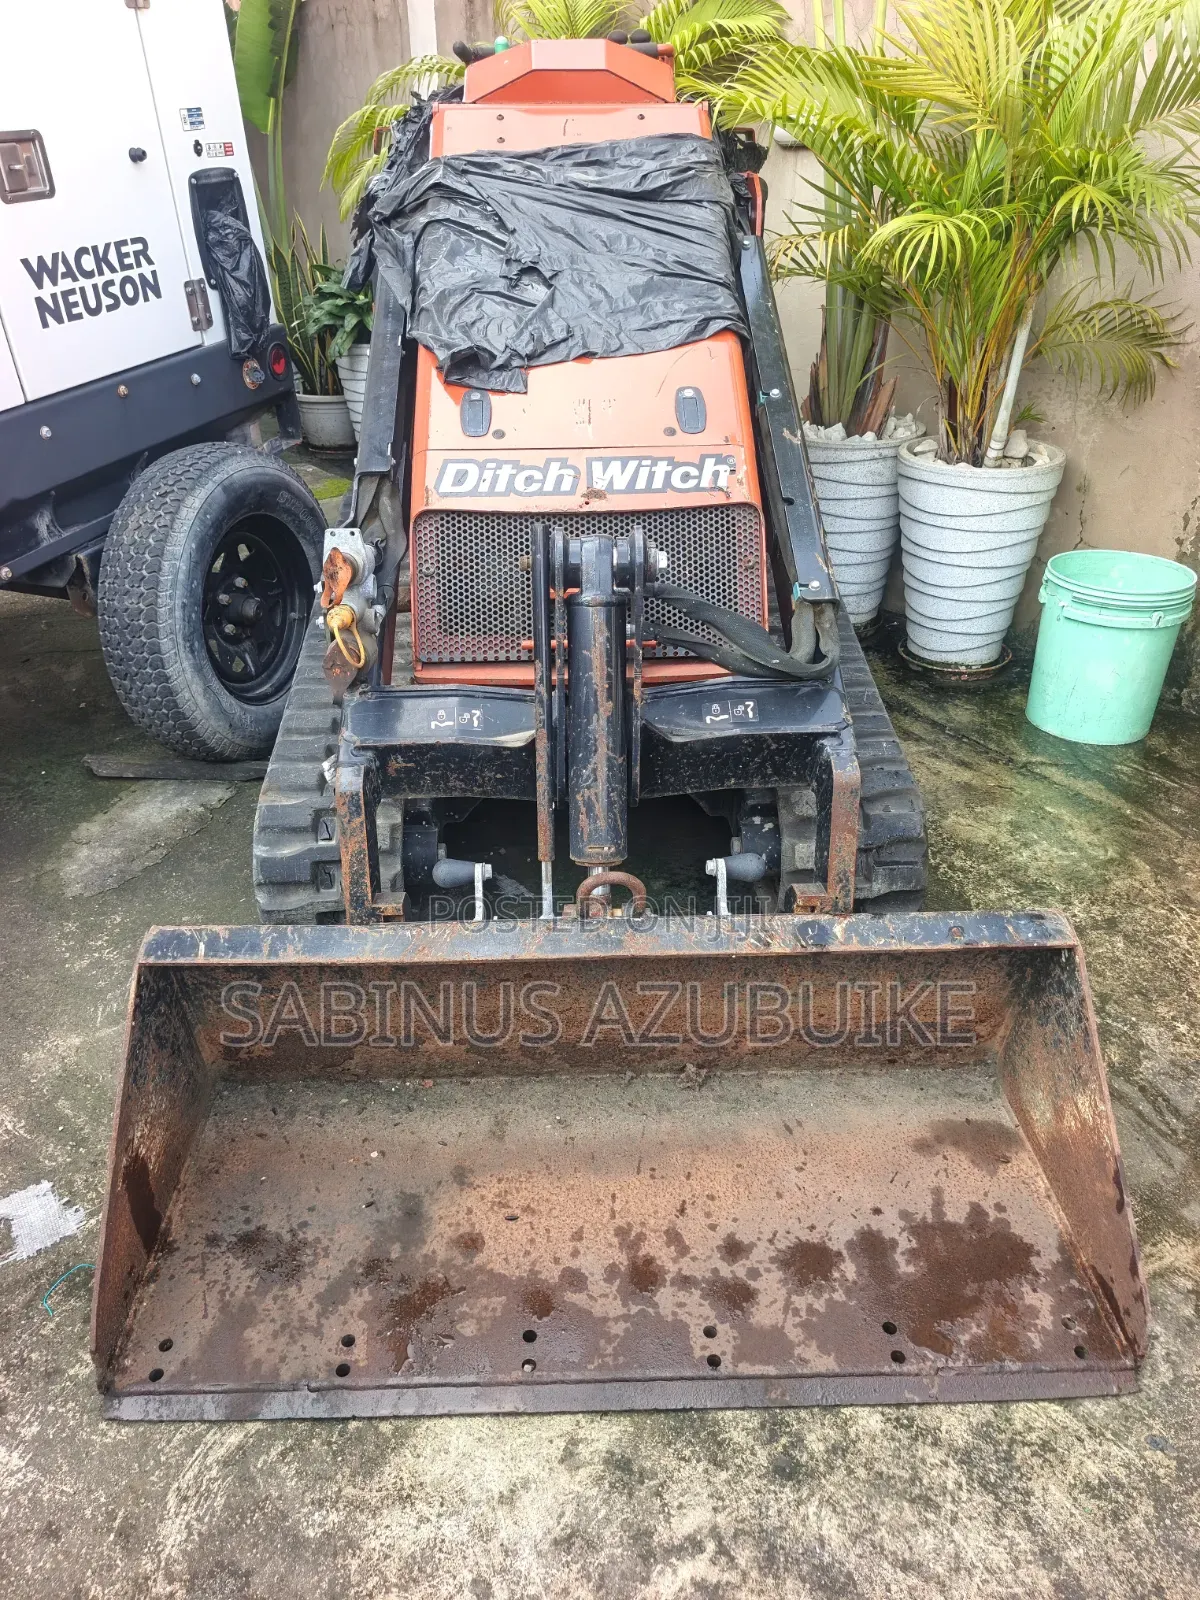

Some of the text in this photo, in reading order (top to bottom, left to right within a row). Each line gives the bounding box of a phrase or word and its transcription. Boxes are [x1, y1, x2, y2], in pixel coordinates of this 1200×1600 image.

[20, 236, 155, 290] WACKER
[34, 269, 162, 329] NEUSON
[438, 461, 576, 493] Ditch
